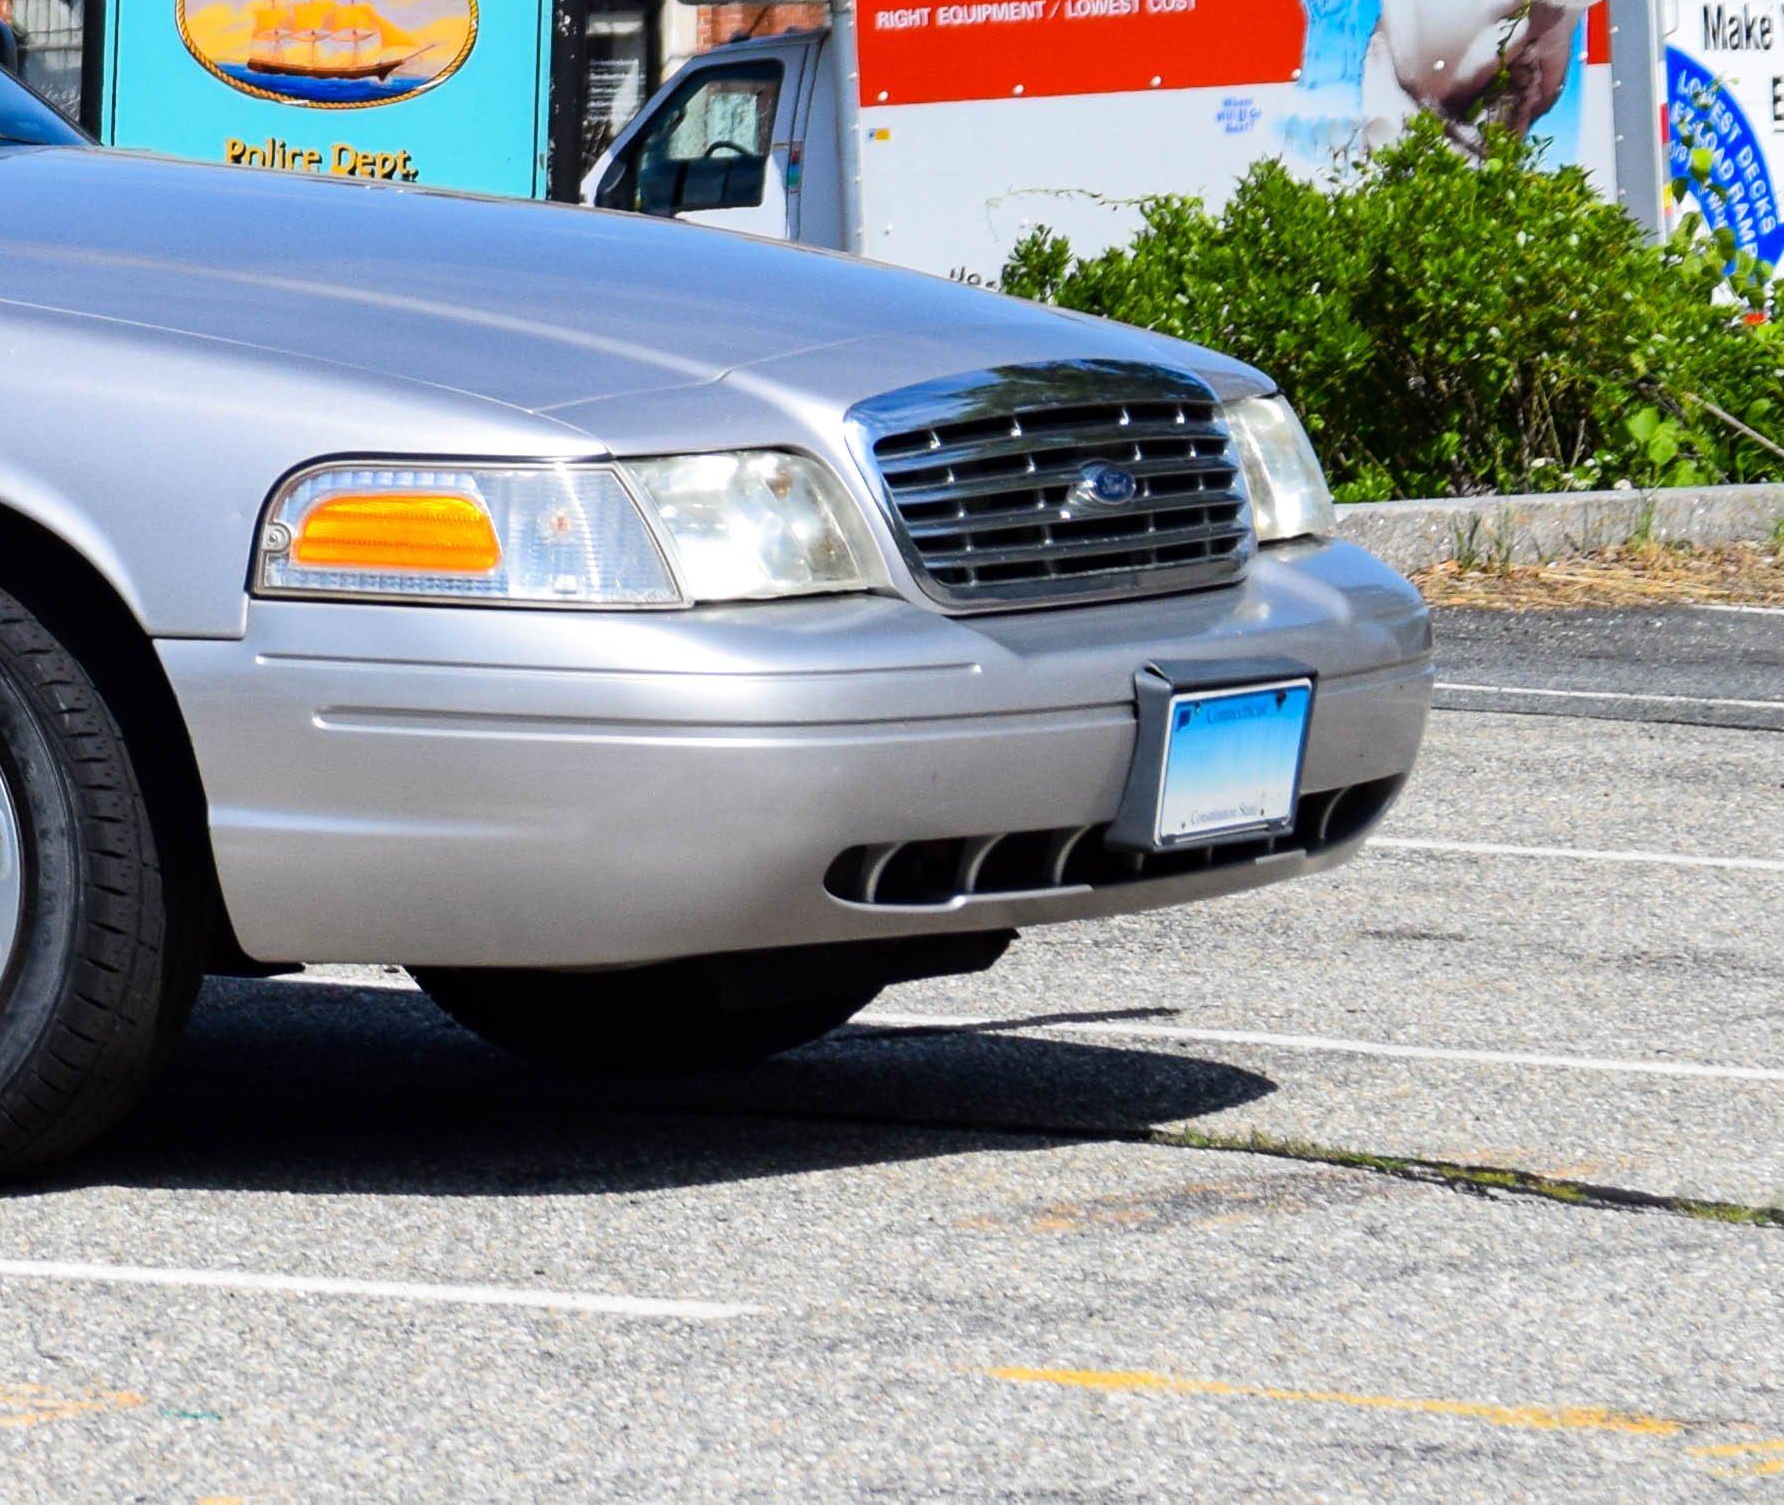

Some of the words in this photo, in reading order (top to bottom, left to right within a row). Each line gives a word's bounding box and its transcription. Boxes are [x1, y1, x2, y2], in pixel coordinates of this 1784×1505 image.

[875, 7, 930, 30] RIGHT
[936, 0, 1047, 28] EQUIPMENT
[1702, 2, 1773, 52] Make
[331, 143, 419, 182] Dept.
[1735, 144, 1777, 236] DECKS
